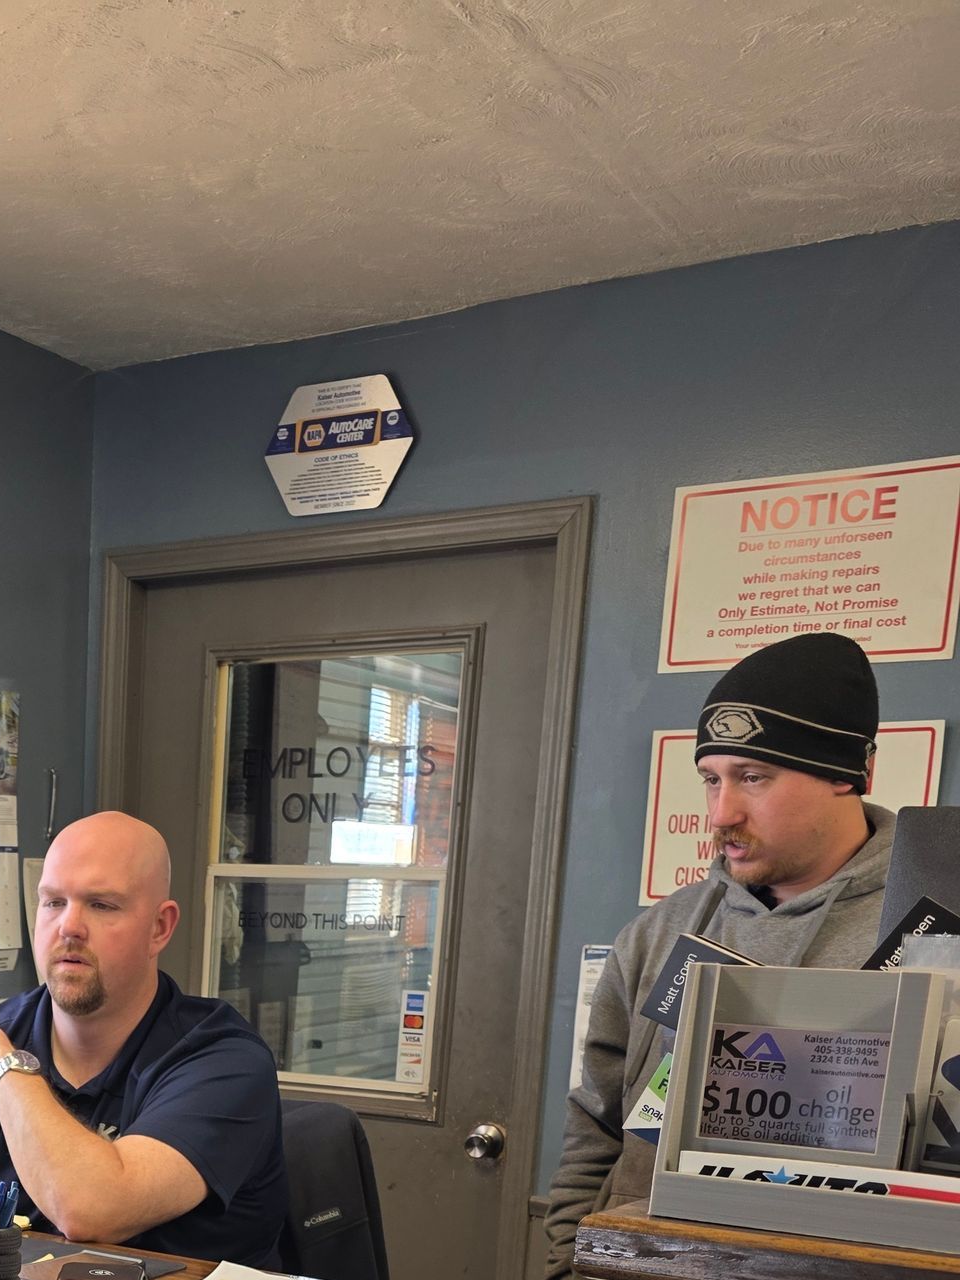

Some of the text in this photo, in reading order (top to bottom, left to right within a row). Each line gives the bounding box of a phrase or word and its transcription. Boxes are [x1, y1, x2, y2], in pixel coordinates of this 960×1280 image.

[337, 432, 363, 443] CENTER
[741, 486, 899, 532] NOTICE
[738, 529, 893, 552] Due to many unforseen
[764, 550, 861, 567] circumstances
[743, 565, 880, 584] while making repairs
[738, 582, 880, 601] we regret that we can
[719, 597, 898, 619] Only Estimate, Not Promise
[707, 616, 907, 637] a completion time or final cost
[281, 792, 373, 824] ONLY
[668, 814, 699, 834] OUR
[238, 911, 407, 932] BEYOND THIS POINT
[913, 914, 936, 937] oen
[657, 986, 680, 1014] Matt
[712, 1029, 786, 1062] KA
[804, 1034, 890, 1047] Kaiser Automotive
[810, 1055, 878, 1066] 2324 6th Ave
[814, 1046, 878, 1056] 405-338-9495
[709, 1069, 785, 1081] AUTOMOTIVE
[710, 1057, 786, 1074] KAISER
[811, 1068, 885, 1079] kaiserautomotive.com
[702, 1081, 790, 1120] $100
[827, 1085, 852, 1103] oil
[799, 1101, 874, 1126] change
[730, 1115, 824, 1132] to quarts full
[732, 1127, 827, 1146] BG oil additive.
